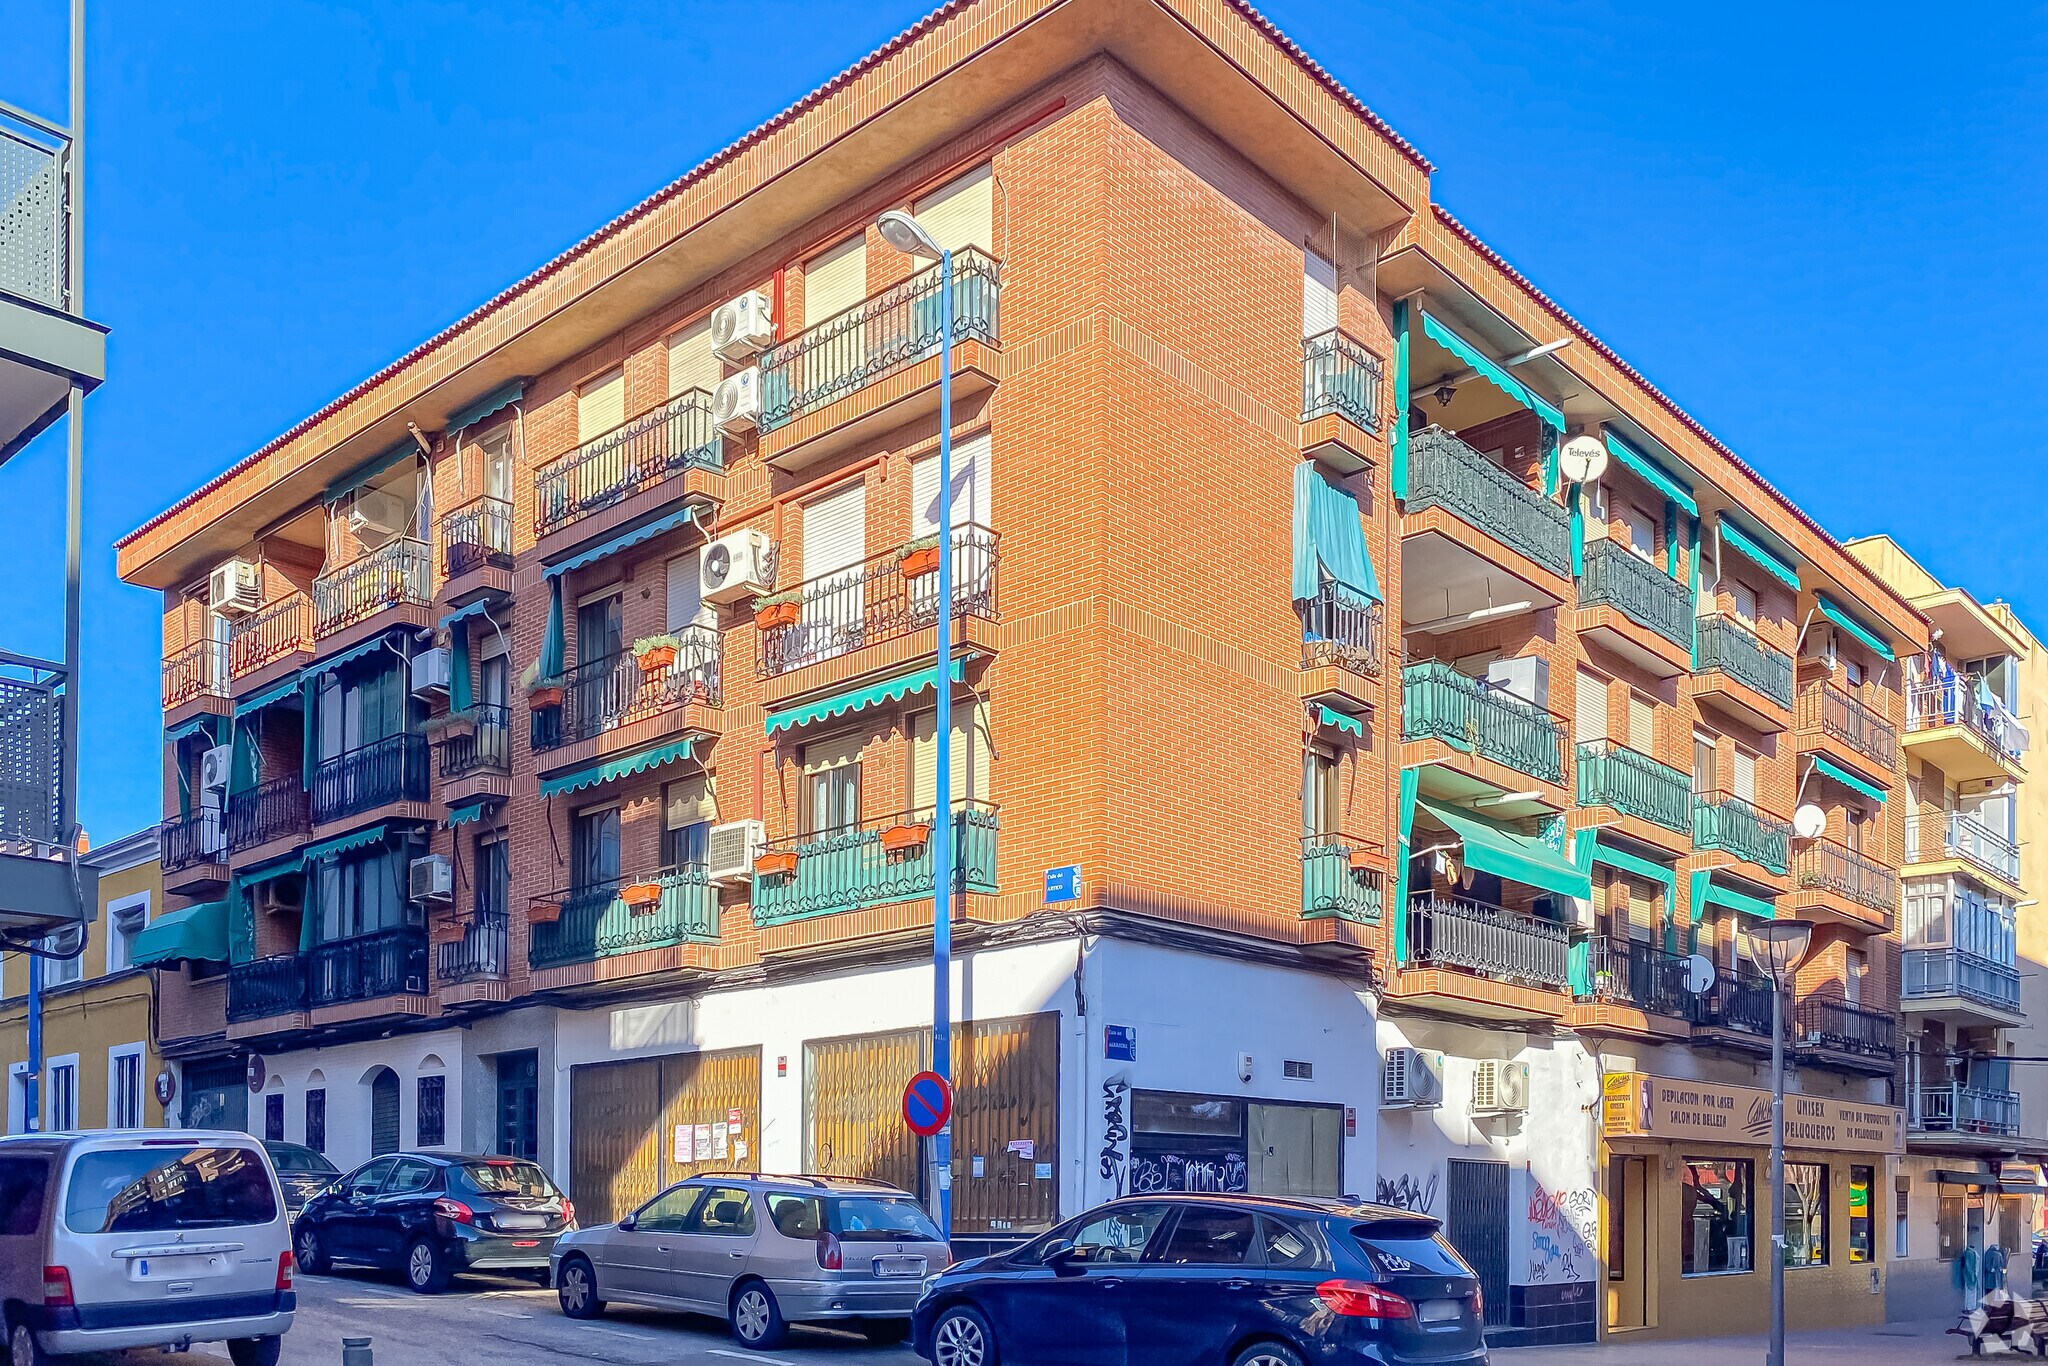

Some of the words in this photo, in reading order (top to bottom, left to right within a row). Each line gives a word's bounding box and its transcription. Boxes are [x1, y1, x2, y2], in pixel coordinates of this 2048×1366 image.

[1568, 447, 1600, 457] Televés
[1662, 1089, 1699, 1106] DEPILACION
[1703, 1093, 1715, 1108] POR
[1717, 1095, 1735, 1110] LASER
[1796, 1099, 1825, 1117] UNISEX
[1670, 1110, 1691, 1125] SALON
[1692, 1112, 1700, 1125] DE
[1702, 1113, 1727, 1128] BELLEZA
[1839, 1110, 1855, 1122] VENTA
[1855, 1111, 1863, 1123] DE
[1863, 1112, 1890, 1126] PRODUCTOS
[1784, 1121, 1836, 1141] PELUQUEROS
[1846, 1127, 1853, 1138] DE
[1854, 1127, 1883, 1141] PELUQUERIA
